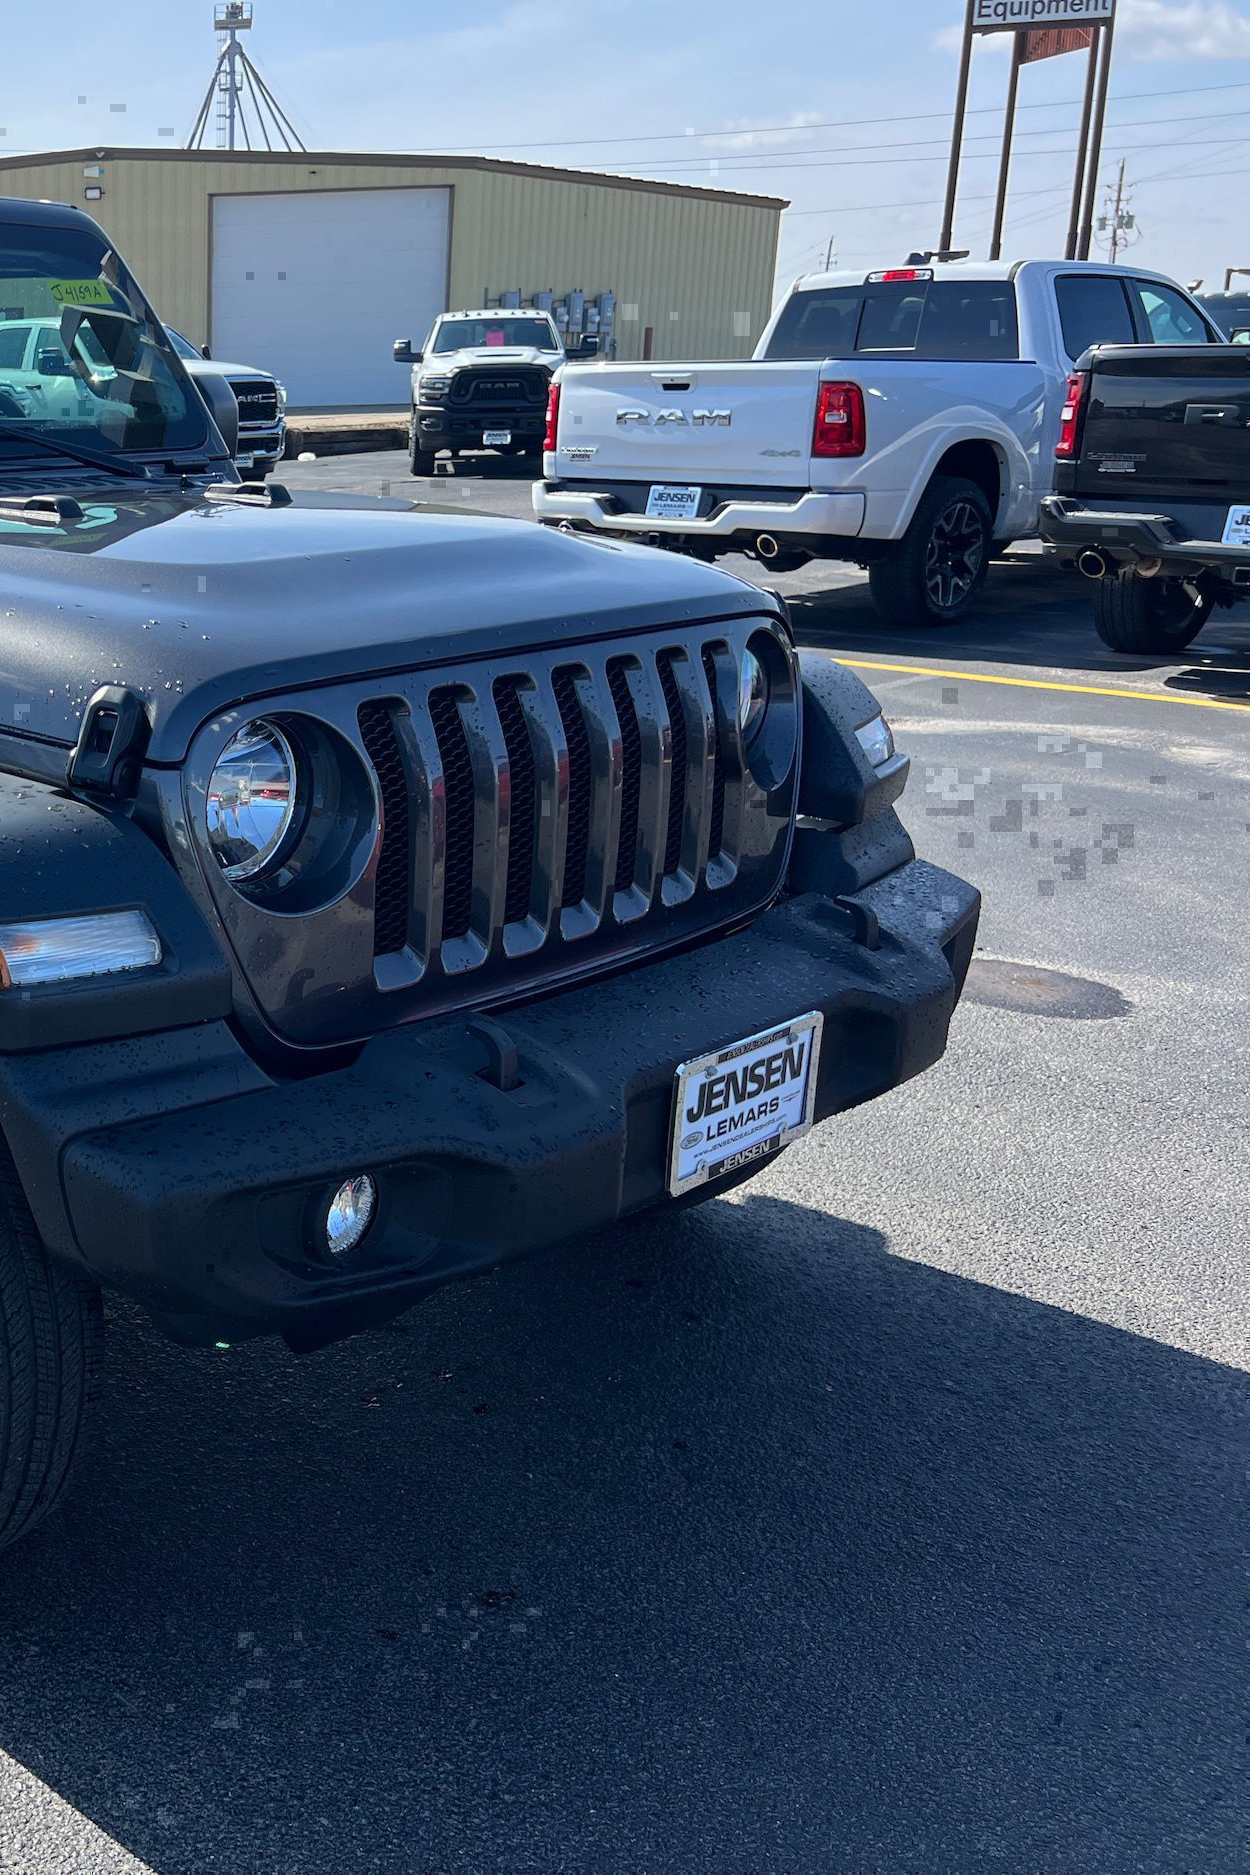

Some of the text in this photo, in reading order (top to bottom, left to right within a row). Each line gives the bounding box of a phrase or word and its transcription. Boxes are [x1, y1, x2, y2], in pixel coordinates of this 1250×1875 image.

[977, 0, 1109, 21] Equipment
[616, 408, 733, 427] RAM
[653, 492, 697, 504] JENSEN
[686, 1043, 805, 1124] JENSEN
[706, 1096, 780, 1142] LEMARS
[719, 1139, 770, 1173] JENSEN
